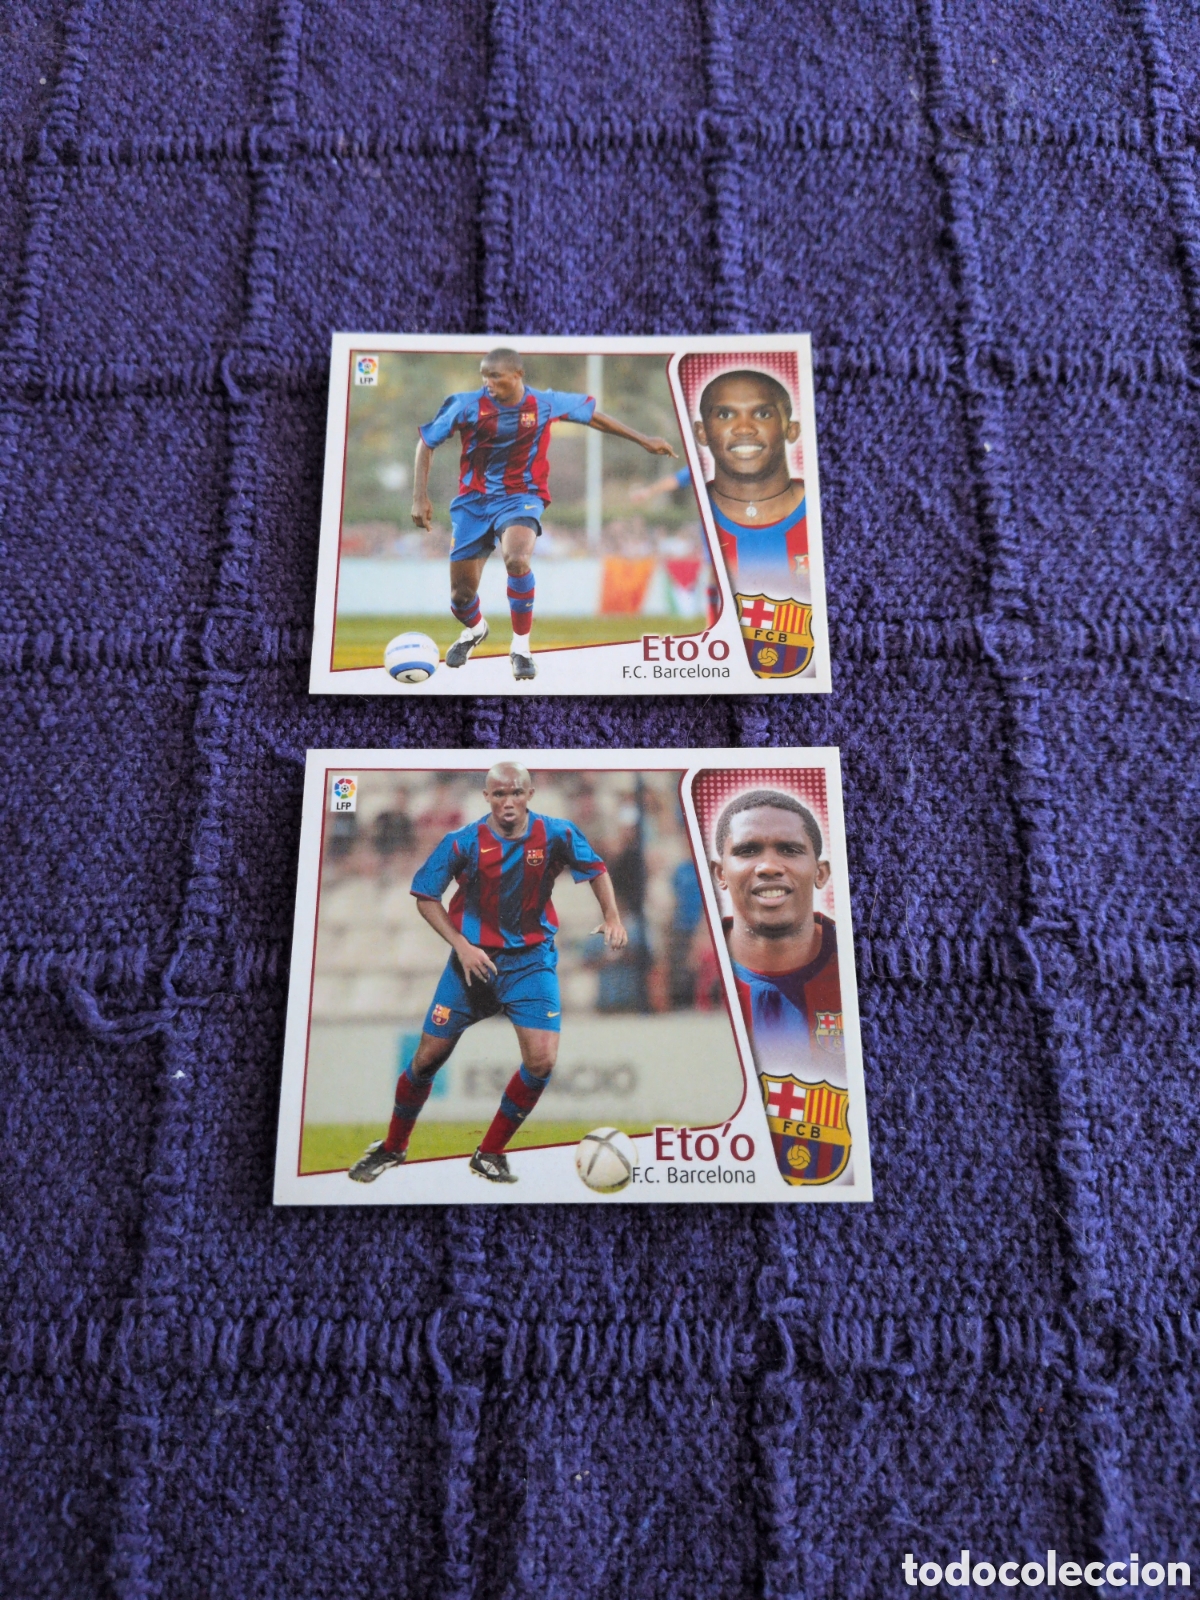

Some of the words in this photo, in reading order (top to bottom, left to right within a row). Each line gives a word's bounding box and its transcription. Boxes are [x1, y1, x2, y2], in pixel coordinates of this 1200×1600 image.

[359, 377, 374, 385] LFP
[754, 629, 788, 643] FCB
[622, 665, 647, 679] F.C.
[653, 664, 730, 679] Barcelona
[336, 802, 352, 811] LFP
[782, 1120, 821, 1139] FCB
[632, 1167, 660, 1184] F.C.
[667, 1166, 756, 1184] Barcelona
